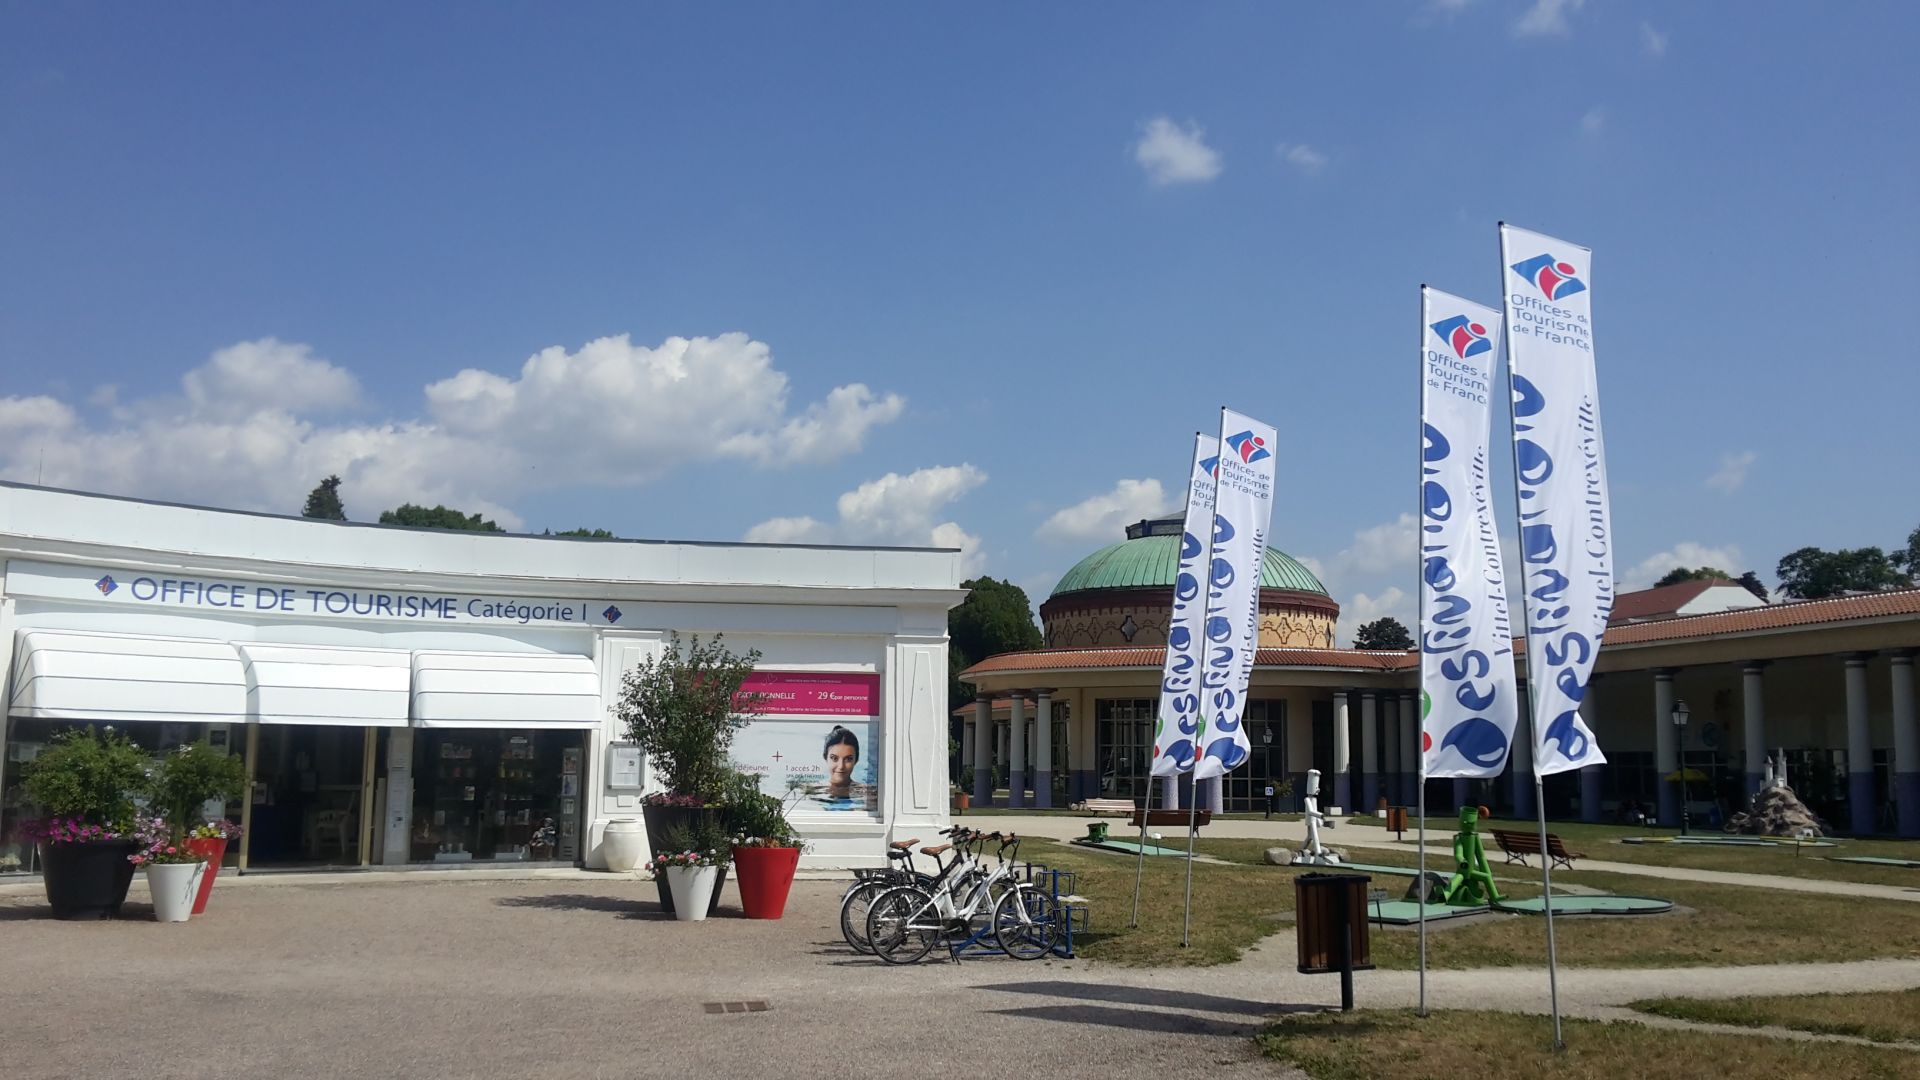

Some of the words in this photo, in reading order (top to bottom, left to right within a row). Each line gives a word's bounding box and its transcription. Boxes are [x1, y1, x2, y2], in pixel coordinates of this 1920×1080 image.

[1511, 293, 1572, 319] Offices
[1512, 323, 1529, 335] de
[1428, 350, 1478, 376] Offices
[1428, 362, 1488, 393] Tourism
[1427, 378, 1439, 389] de
[1443, 381, 1487, 405] Franc
[1221, 457, 1255, 477] Offices
[1258, 473, 1270, 481] de
[1221, 467, 1270, 490] Tourisme
[1193, 479, 1216, 493] Offic
[1219, 479, 1230, 487] de
[1232, 481, 1269, 500] France
[131, 577, 246, 608] OFFICE
[255, 587, 296, 611] DE
[306, 590, 458, 619] TOURISME
[467, 598, 574, 624] Catégorie
[817, 691, 829, 700] 29
